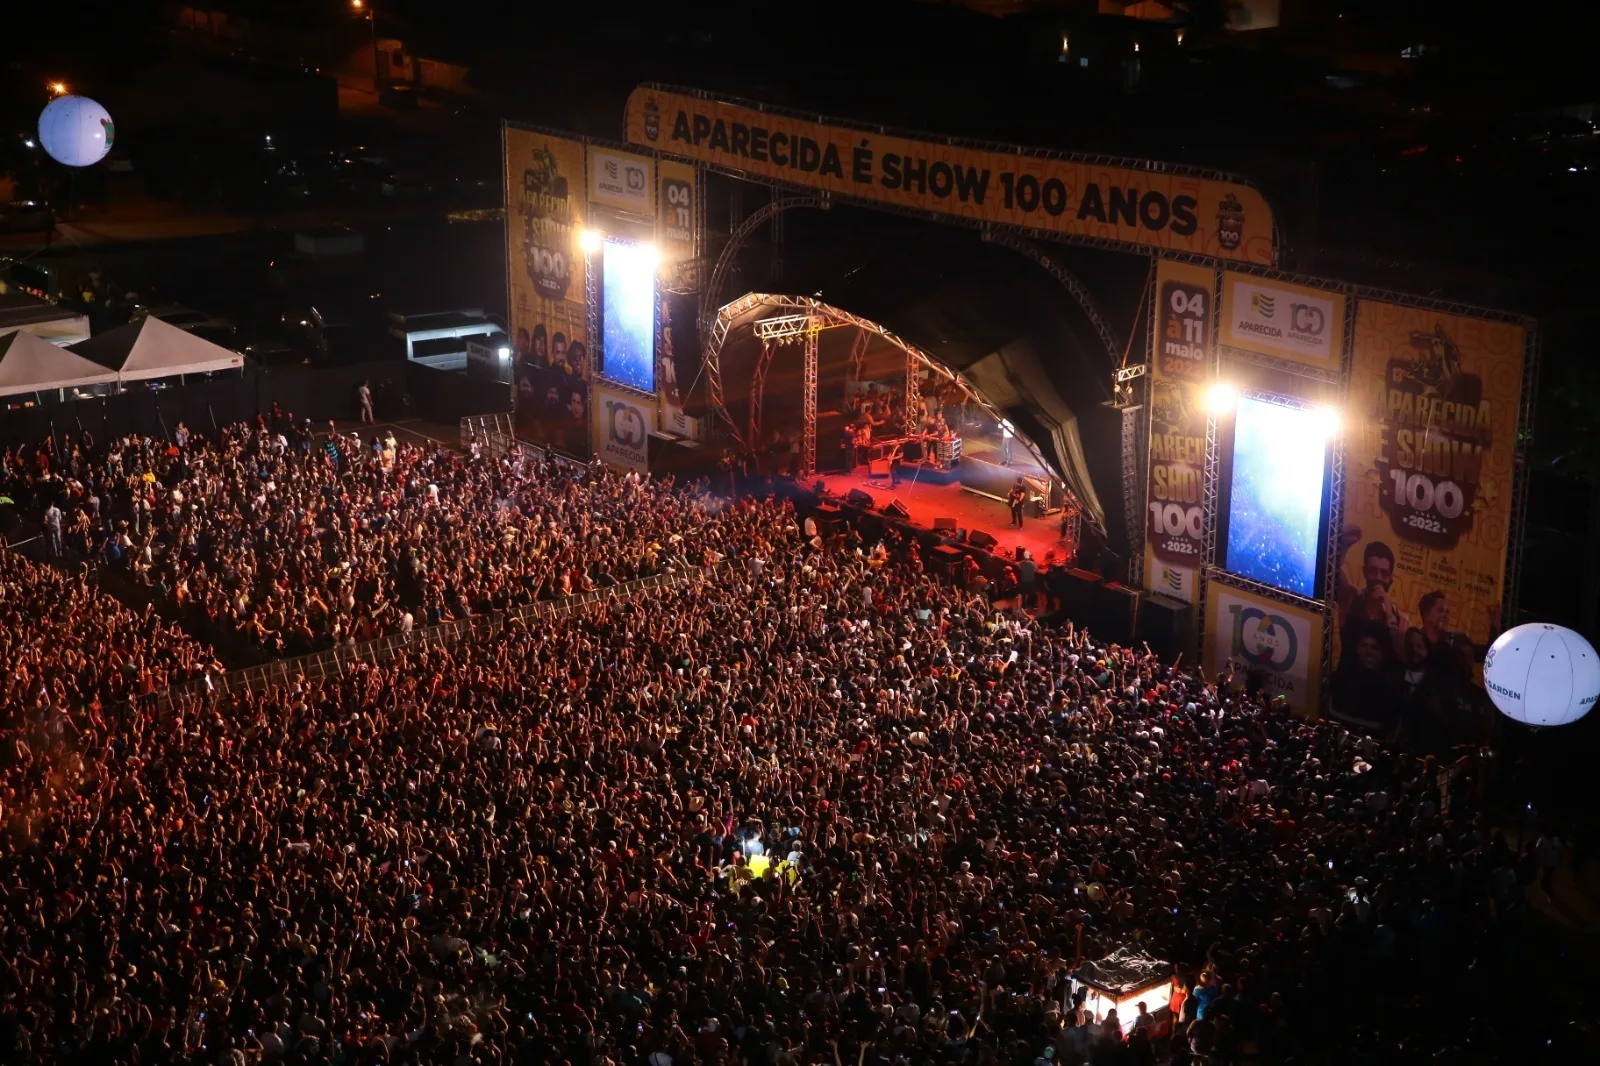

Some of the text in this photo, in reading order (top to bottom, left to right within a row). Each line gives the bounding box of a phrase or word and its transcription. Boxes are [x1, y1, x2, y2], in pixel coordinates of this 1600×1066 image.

[672, 110, 1198, 236] APARECIDA É SHOW 100 ANOS
[668, 184, 690, 206] 04
[676, 207, 690, 228] 11
[666, 226, 691, 241] maio
[1220, 230, 1239, 242] 100
[530, 246, 563, 278] 100
[1170, 289, 1205, 318] 04
[1167, 313, 1204, 344] à 11
[1238, 320, 1283, 339] APARECIDA
[1289, 302, 1325, 336] 100
[1165, 341, 1204, 361] maio
[1287, 331, 1323, 346] APARECIDA
[1164, 356, 1200, 376] 202
[1375, 381, 1492, 431] APARECIDA
[605, 400, 646, 451] 100
[605, 443, 646, 465] APARECIDA
[1150, 432, 1204, 464] ARECI
[1396, 428, 1482, 484] SHOW
[1390, 468, 1464, 519] 100
[1149, 501, 1203, 540] 100
[1408, 514, 1441, 534] 2022
[1167, 541, 1193, 554] 2022
[1229, 604, 1298, 673] 100
[1224, 660, 1295, 692] APACIDA
